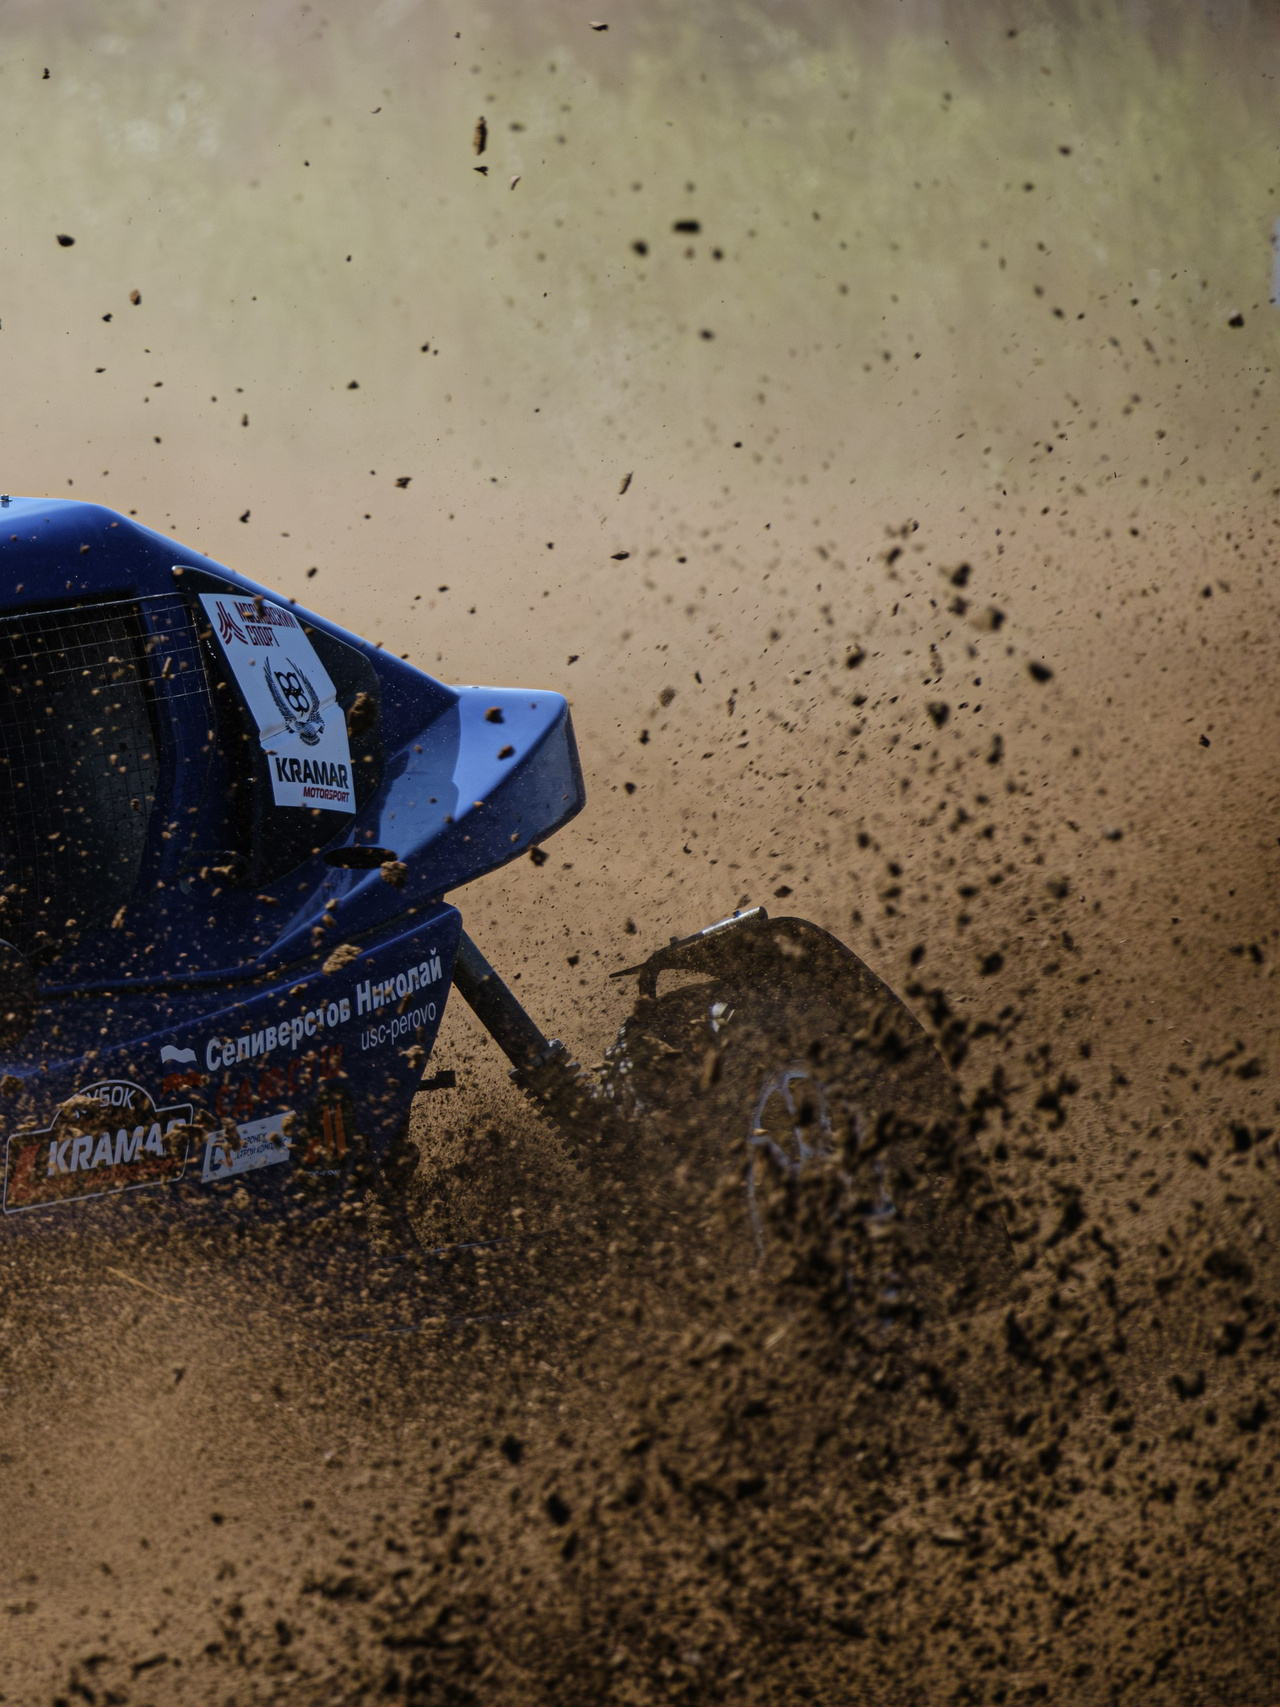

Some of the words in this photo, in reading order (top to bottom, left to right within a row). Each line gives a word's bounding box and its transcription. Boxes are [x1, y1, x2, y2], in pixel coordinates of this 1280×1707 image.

[275, 757, 349, 789] KRAMAR
[303, 786, 350, 803] MOTORSPORT
[206, 999, 351, 1071] Селиверстов
[356, 947, 442, 1017] Николай
[361, 1001, 437, 1050] usc-perovo
